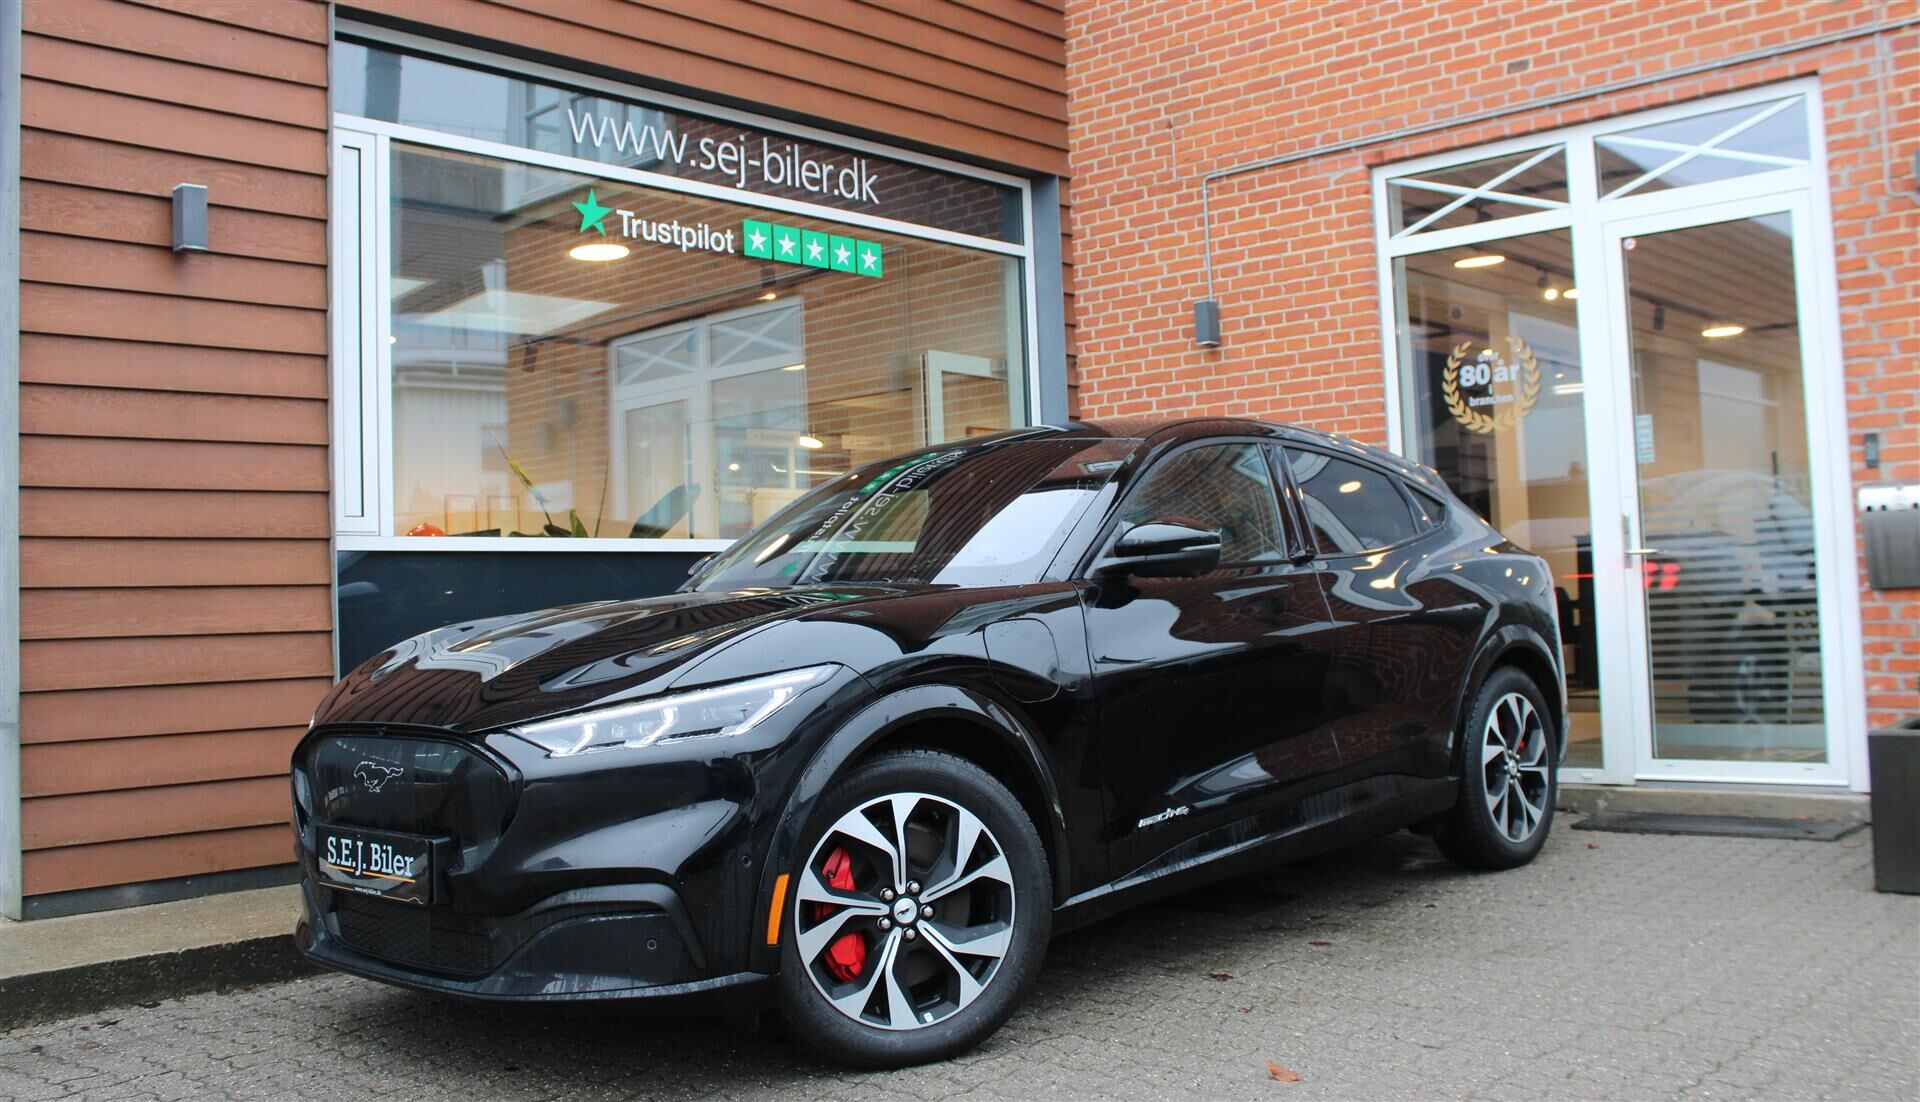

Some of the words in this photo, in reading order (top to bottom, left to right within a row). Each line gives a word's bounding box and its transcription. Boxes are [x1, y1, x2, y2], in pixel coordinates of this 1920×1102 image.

[567, 107, 880, 204] www.sej-biler.dk
[615, 208, 735, 254] Trustpilot
[1459, 363, 1491, 387] 80
[1493, 359, 1520, 382] år
[1468, 395, 1514, 406] branchen
[327, 835, 367, 876] S.E.J.
[370, 843, 414, 877] Biler
